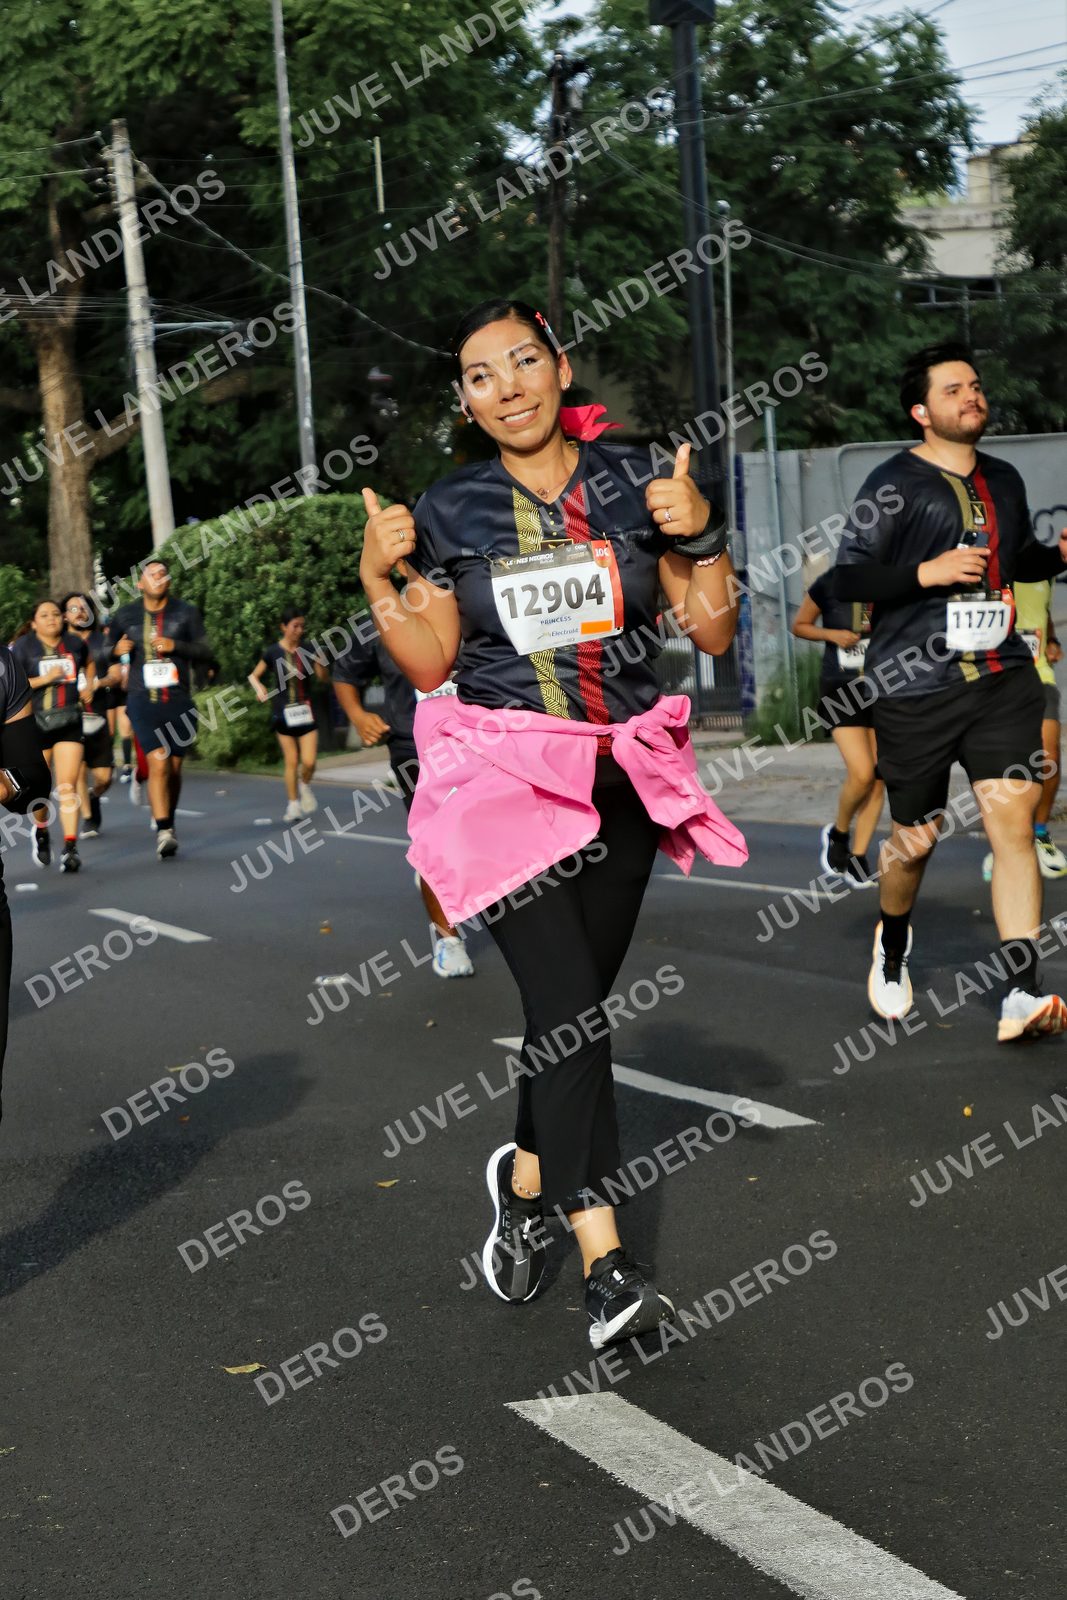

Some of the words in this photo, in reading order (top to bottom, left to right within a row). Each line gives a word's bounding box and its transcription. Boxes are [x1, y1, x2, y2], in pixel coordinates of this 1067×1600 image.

[501, 573, 606, 619] 12904
[540, 616, 572, 625] PRINCESS
[953, 609, 1005, 629] 11771
